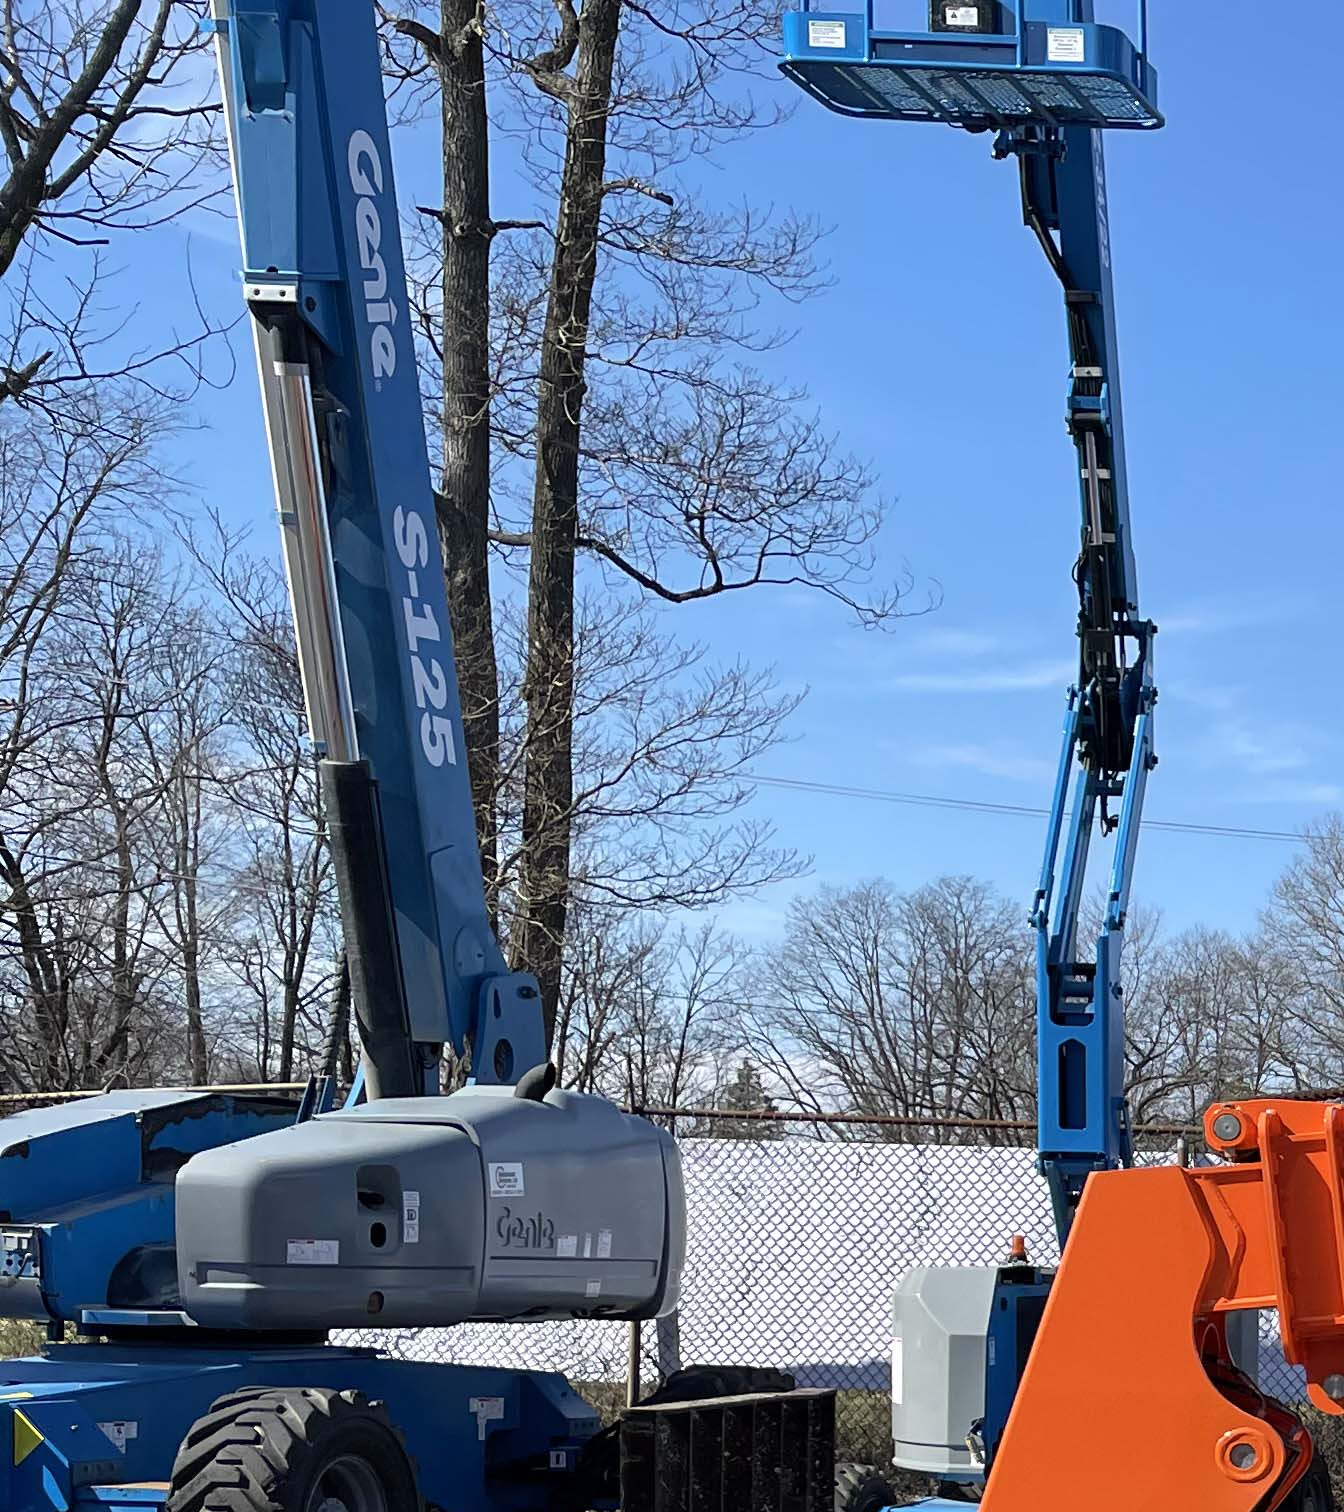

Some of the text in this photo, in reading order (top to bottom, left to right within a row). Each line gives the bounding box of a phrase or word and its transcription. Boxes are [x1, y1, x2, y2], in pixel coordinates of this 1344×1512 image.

[348, 129, 457, 767] Genie S-125
[496, 1206, 555, 1249] Genie
